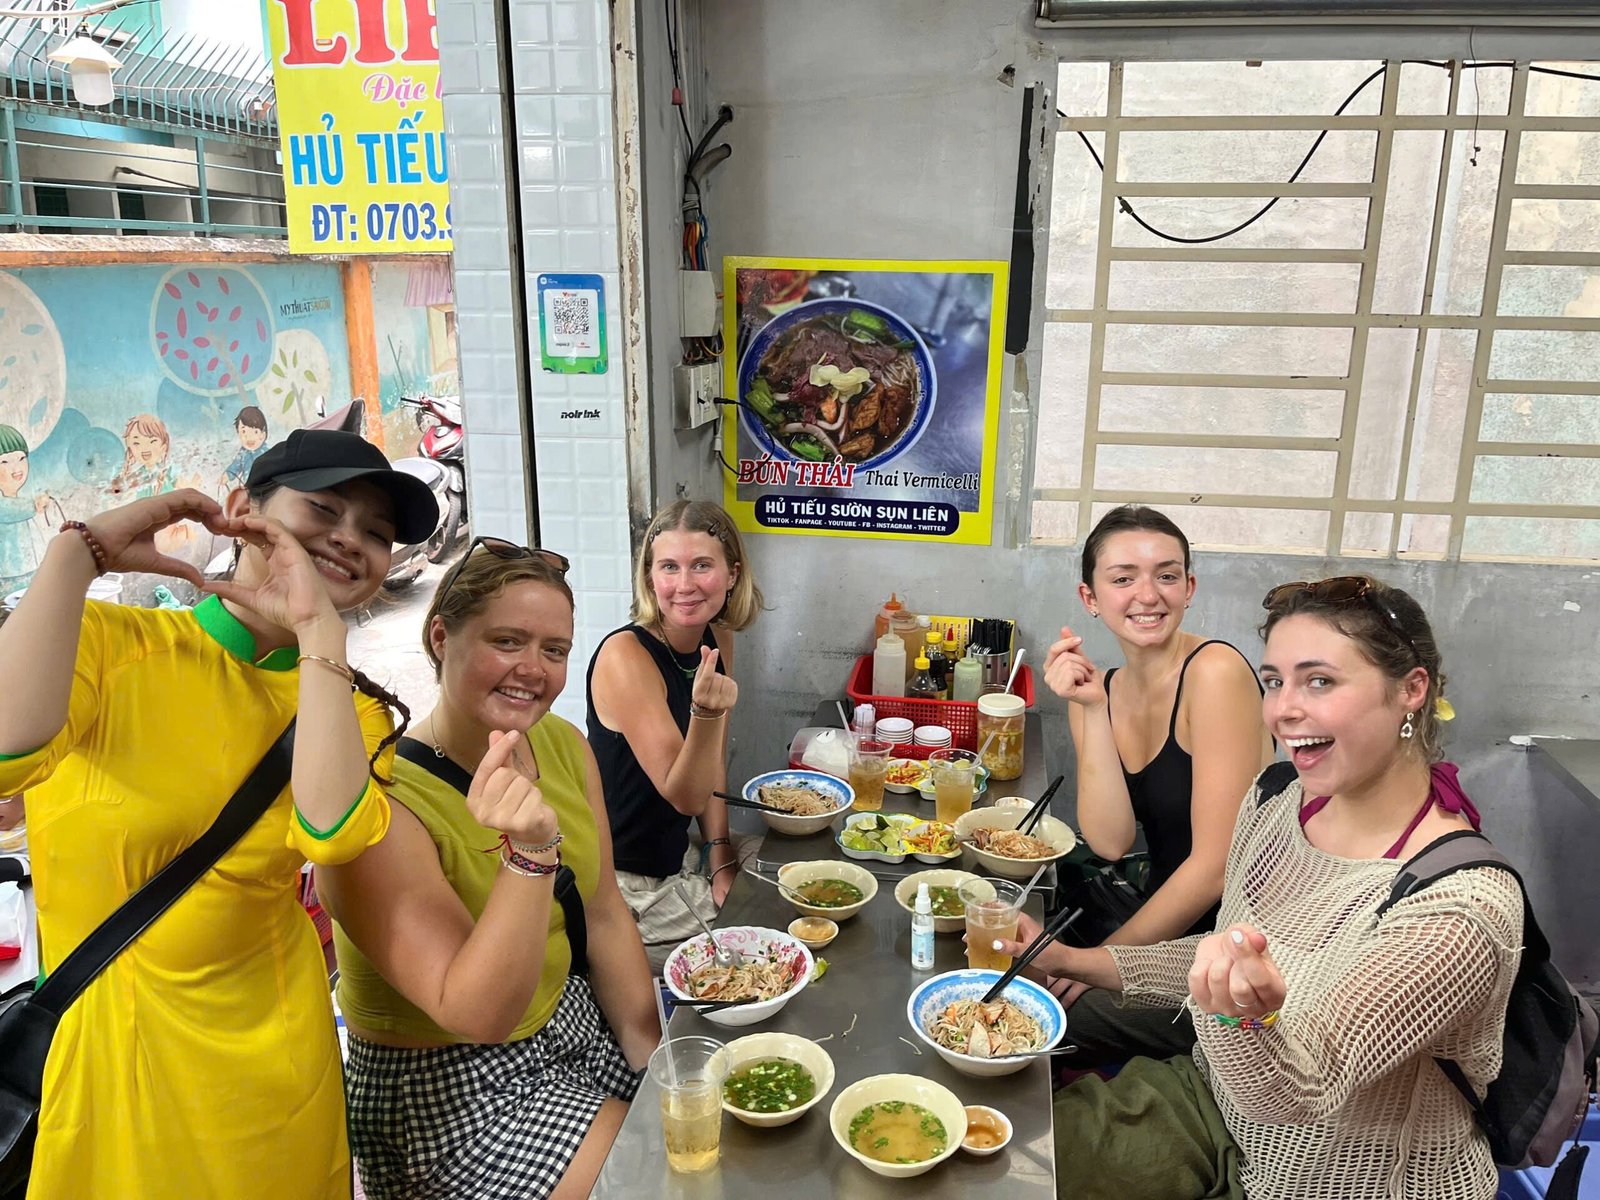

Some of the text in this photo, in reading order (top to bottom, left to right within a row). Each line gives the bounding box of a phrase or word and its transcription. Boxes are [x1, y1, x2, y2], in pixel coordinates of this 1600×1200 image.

[364, 74, 427, 108] Đặc
[290, 111, 448, 185] HỦ TIẾU
[312, 204, 358, 241] ĐT:
[737, 452, 856, 487] BÚN THÁI
[866, 470, 980, 491] Thai Vermicelli
[765, 497, 949, 522] HỦ TIẾU SƯỜN SỤN LIÊN
[794, 518, 822, 526] FANPAGE
[876, 522, 912, 530] INSTAGRAM
[917, 524, 946, 532] TWITTER
